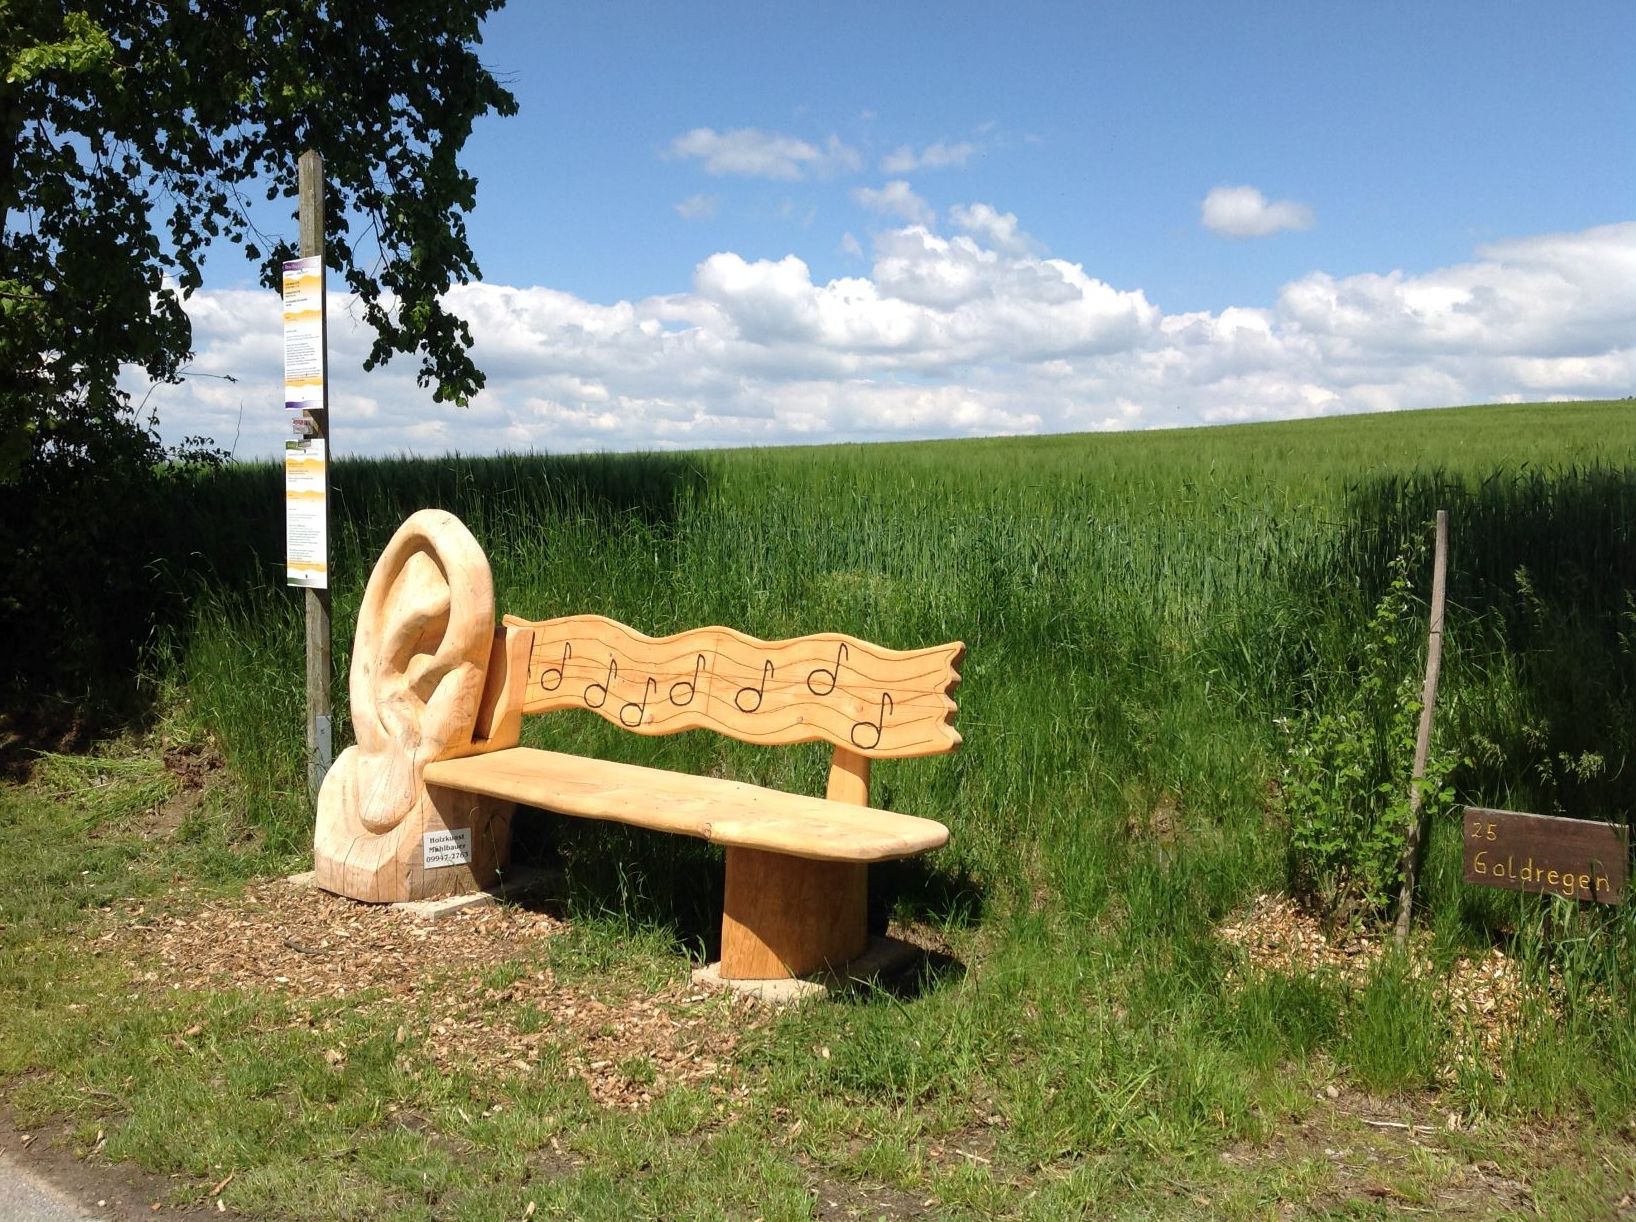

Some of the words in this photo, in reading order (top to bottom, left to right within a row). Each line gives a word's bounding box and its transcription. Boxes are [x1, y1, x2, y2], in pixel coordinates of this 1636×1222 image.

[430, 834, 464, 844] Holzkunst
[1471, 822, 1497, 841] 25
[1474, 851, 1610, 895] Goldregen
